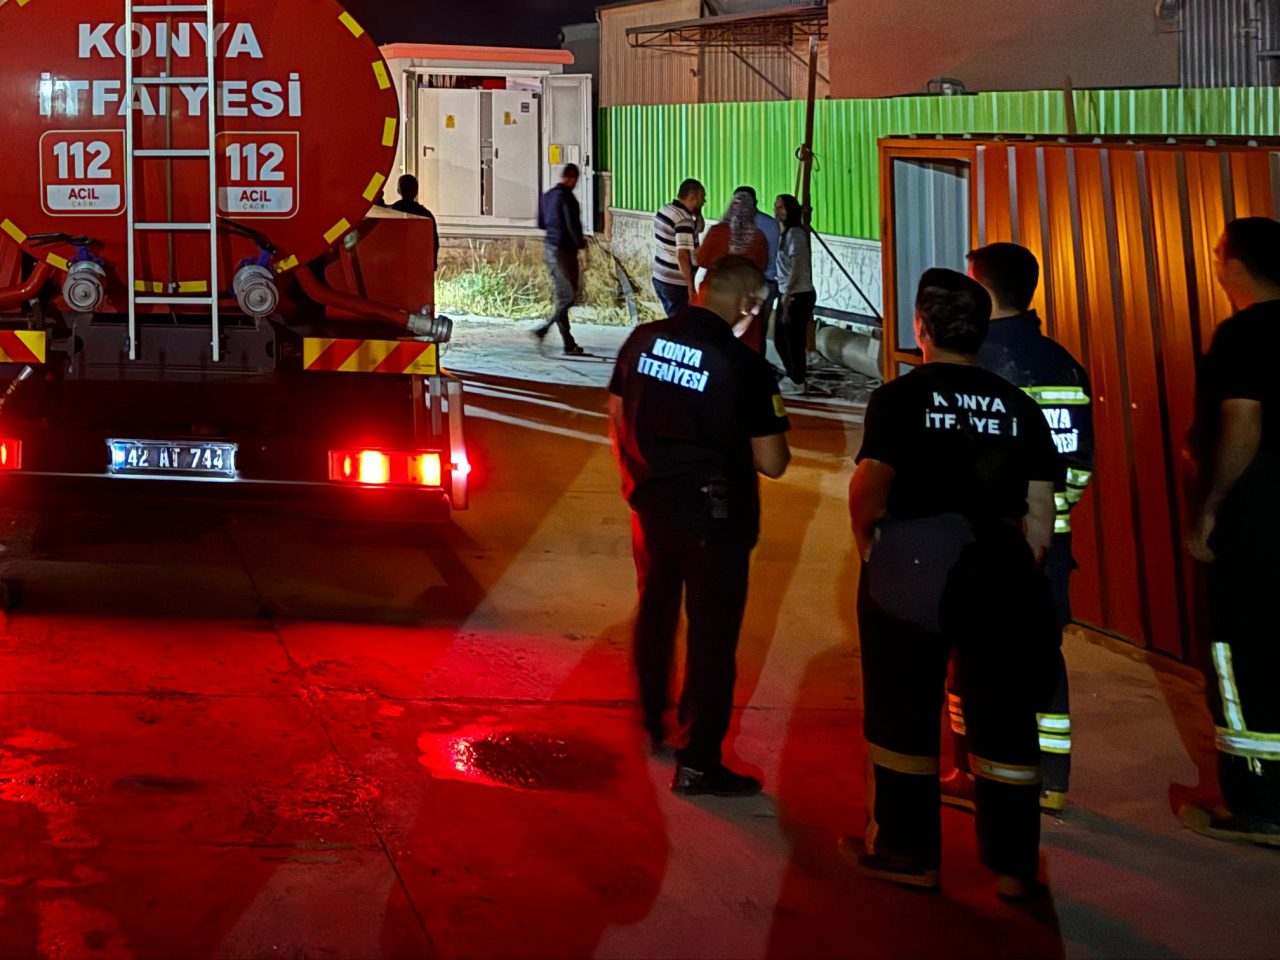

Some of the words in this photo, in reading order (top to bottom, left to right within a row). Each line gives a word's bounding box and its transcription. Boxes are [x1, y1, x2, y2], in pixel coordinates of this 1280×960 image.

[78, 22, 264, 58] KONYA
[39, 72, 302, 117] İTFAİYESİ
[53, 140, 112, 179] 112
[225, 142, 285, 181] 112
[68, 187, 100, 200] ACİL
[239, 189, 272, 202] ACİL
[652, 338, 703, 368] KONYA
[637, 352, 710, 392] İTFAİYESİ
[127, 447, 149, 467] 42
